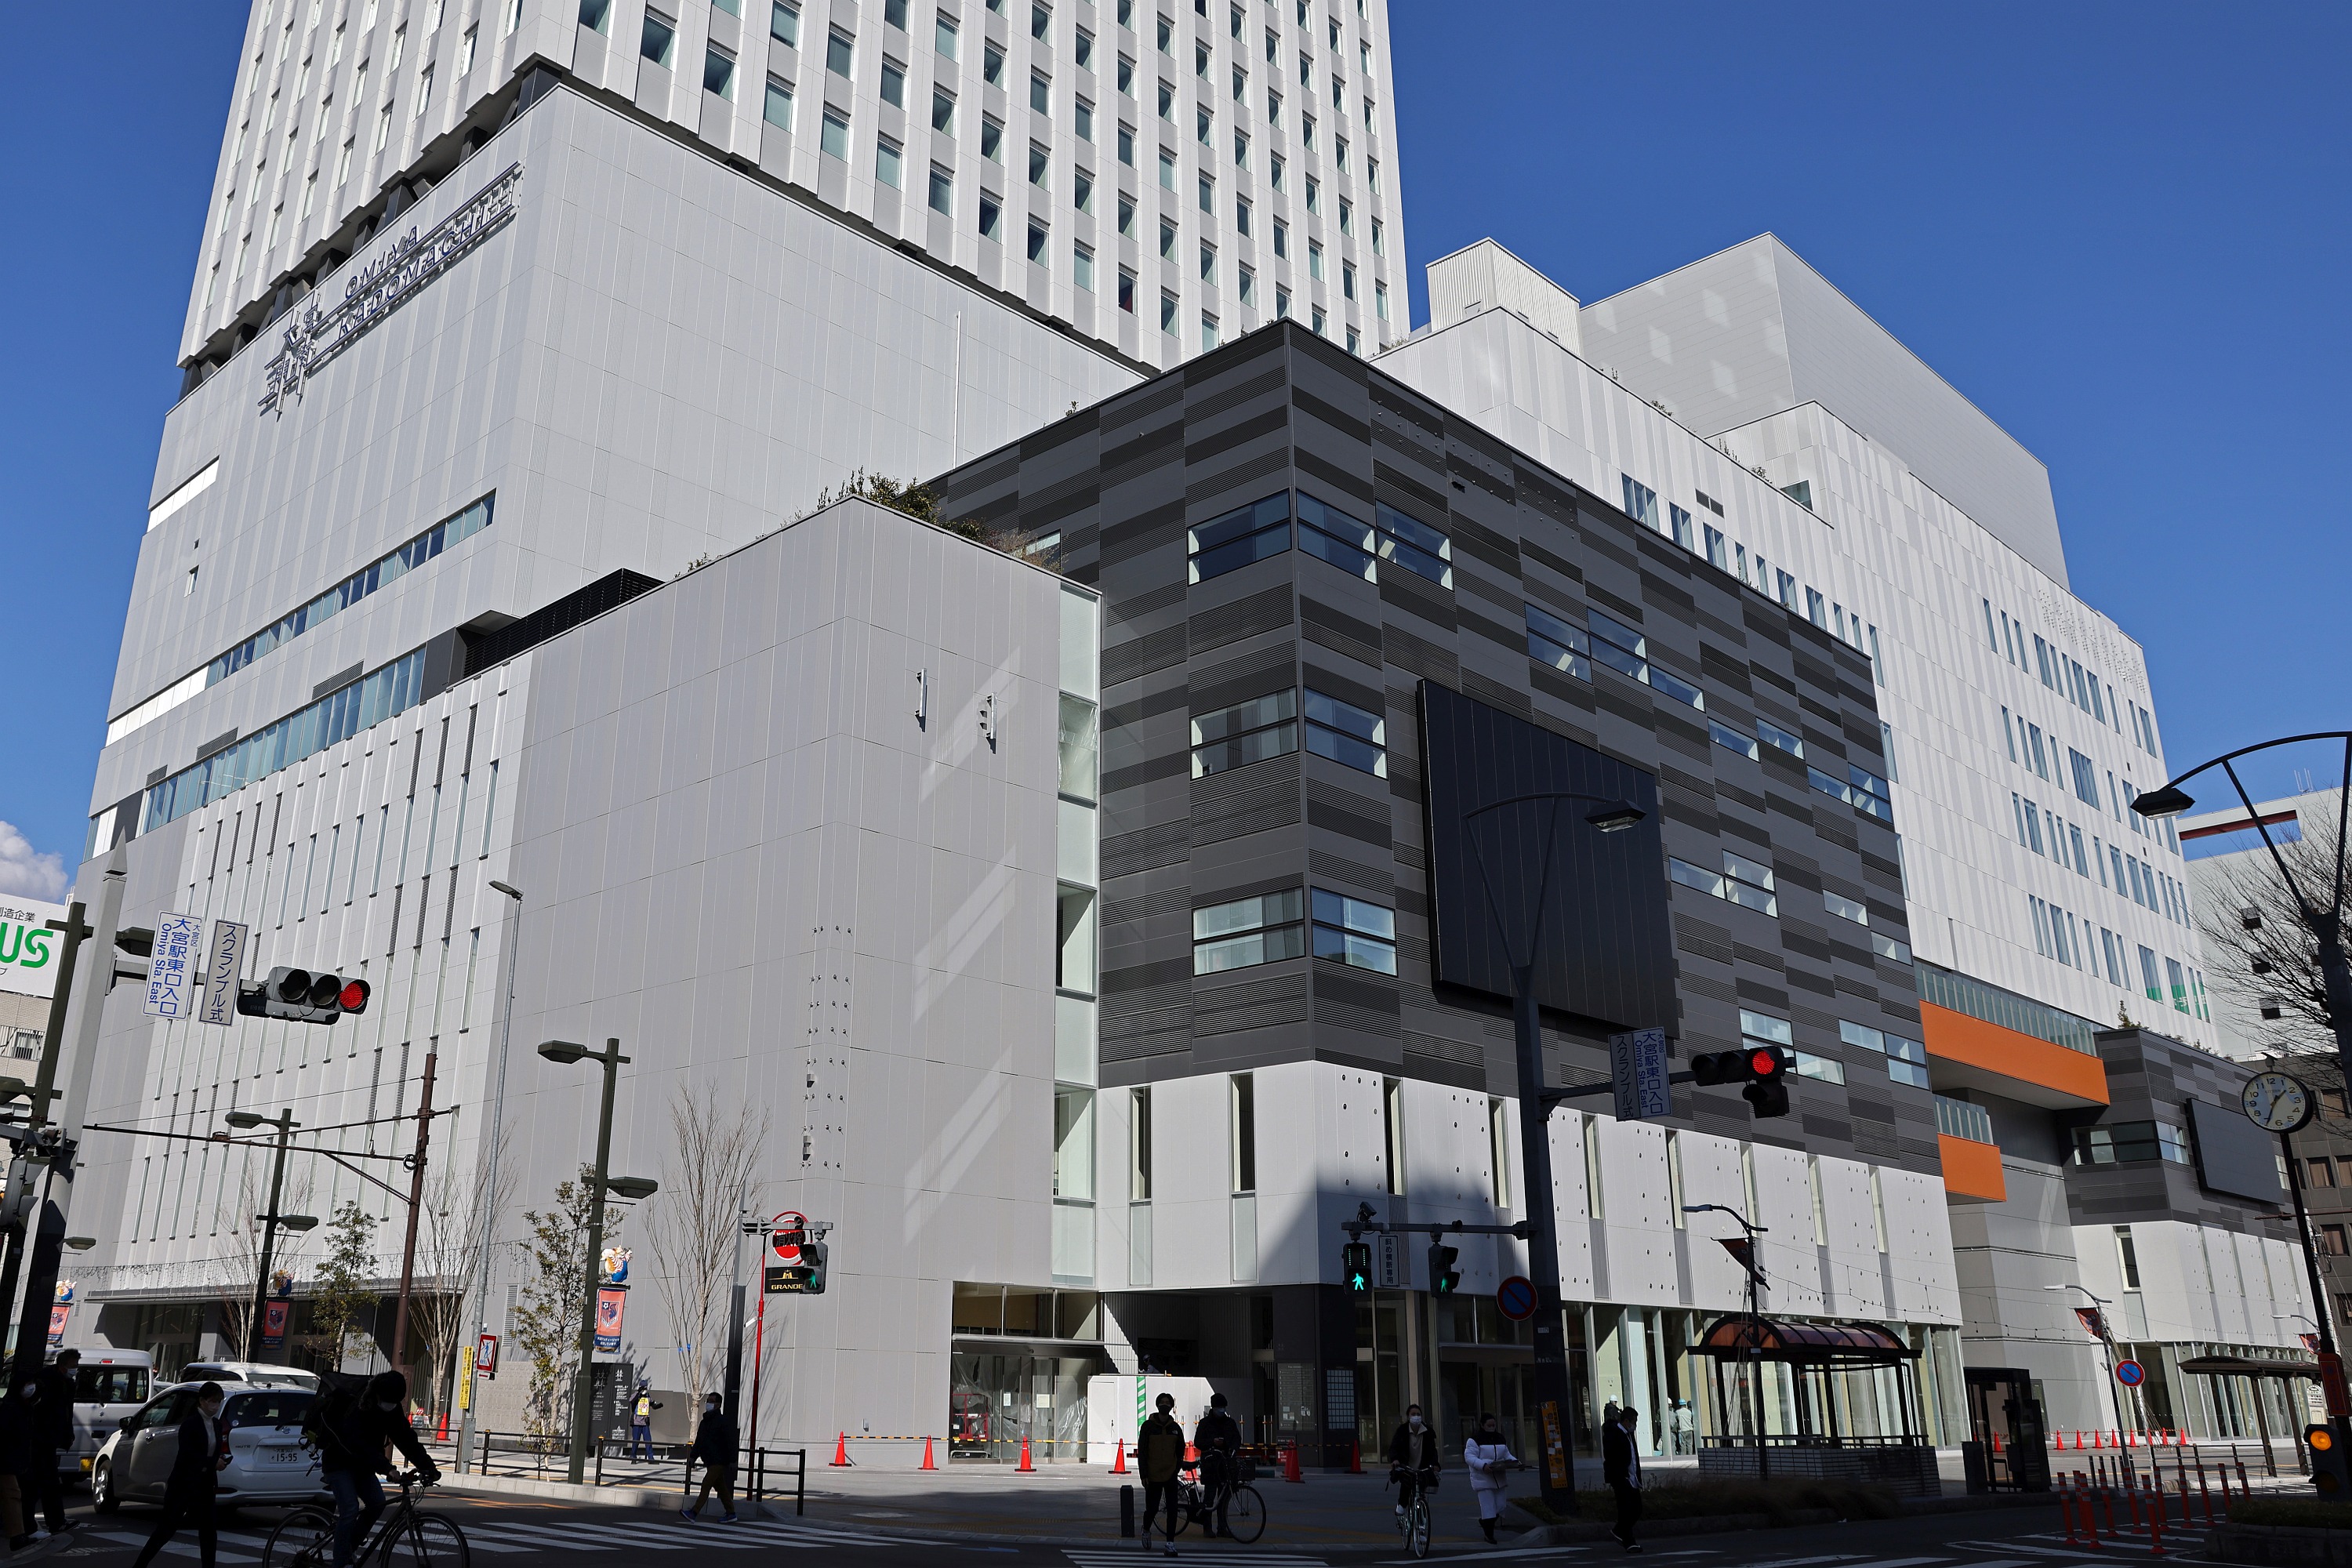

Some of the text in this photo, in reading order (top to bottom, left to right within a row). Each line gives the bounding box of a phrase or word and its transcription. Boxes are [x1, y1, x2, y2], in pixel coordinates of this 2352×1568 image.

[346, 225, 419, 299] OMIYA
[149, 923, 172, 1004] Omiya Sta. East
[160, 918, 192, 1014] 大宮駅東口入口
[190, 924, 201, 946] 大宮区
[209, 925, 237, 1022] スクランブル式
[1617, 1036, 1634, 1118] スクランブル式
[1635, 1040, 1649, 1109] Omiya Sta. East
[1642, 1032, 1663, 1114] 大宮駅東口入口
[776, 1231, 804, 1247] 消火栓
[1385, 1238, 1394, 1284] 斜め横断専用
